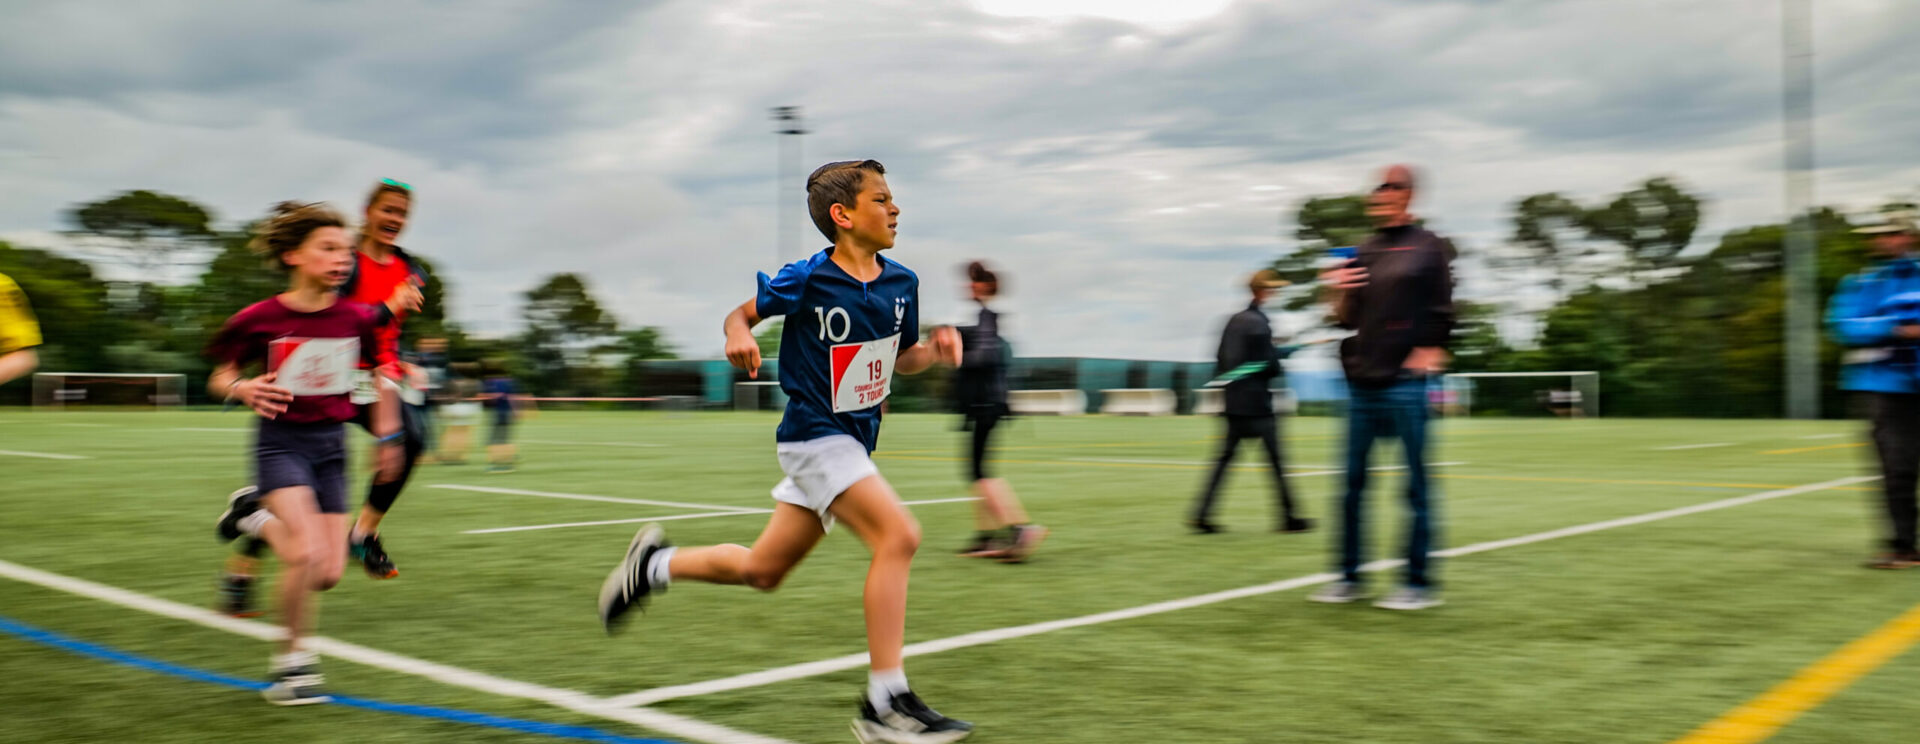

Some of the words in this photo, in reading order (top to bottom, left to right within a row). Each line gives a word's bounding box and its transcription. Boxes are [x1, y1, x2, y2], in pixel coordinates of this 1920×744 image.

[815, 306, 851, 342] 10
[867, 359, 882, 381] 19
[859, 393, 864, 404] 2
[867, 386, 885, 402] TOURS
